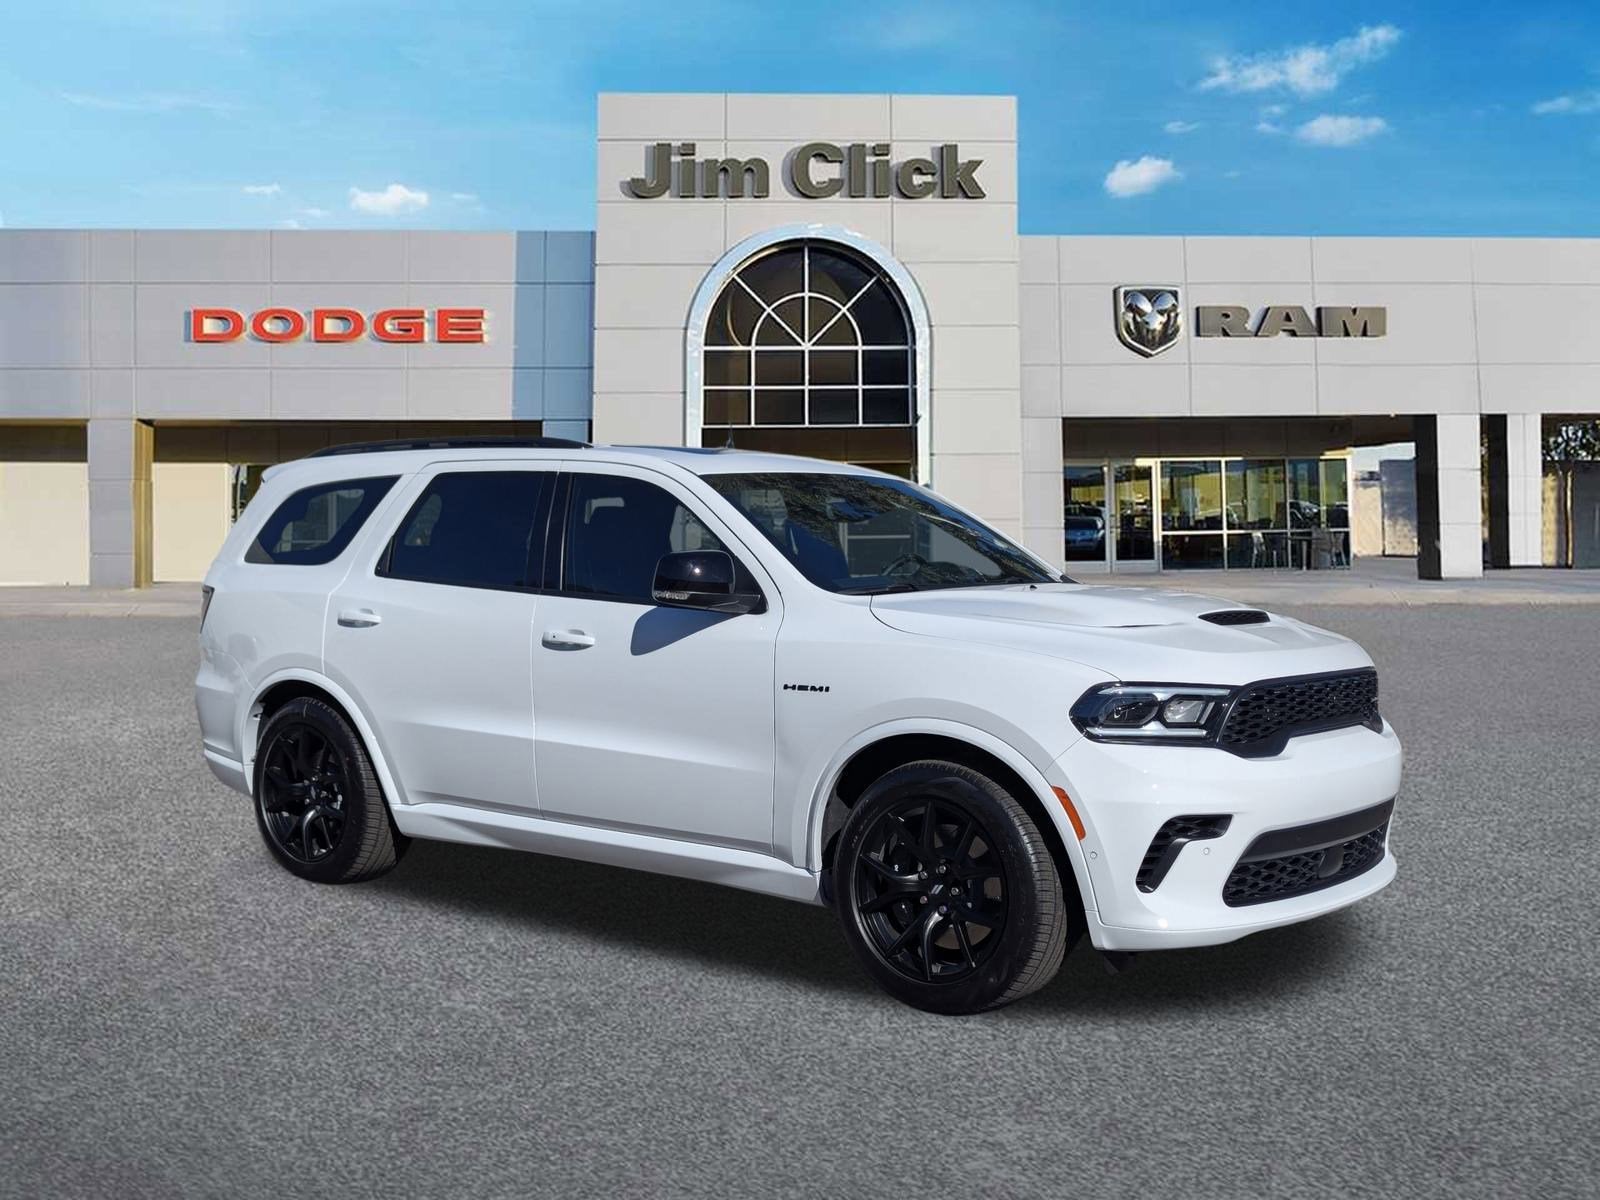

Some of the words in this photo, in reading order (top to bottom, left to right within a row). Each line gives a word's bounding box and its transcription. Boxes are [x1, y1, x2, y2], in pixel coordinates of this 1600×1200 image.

[629, 142, 770, 199] Jim
[791, 142, 986, 199] Click
[190, 308, 486, 343] DODGE
[1196, 305, 1387, 338] RAM
[783, 683, 830, 693] HEMI
